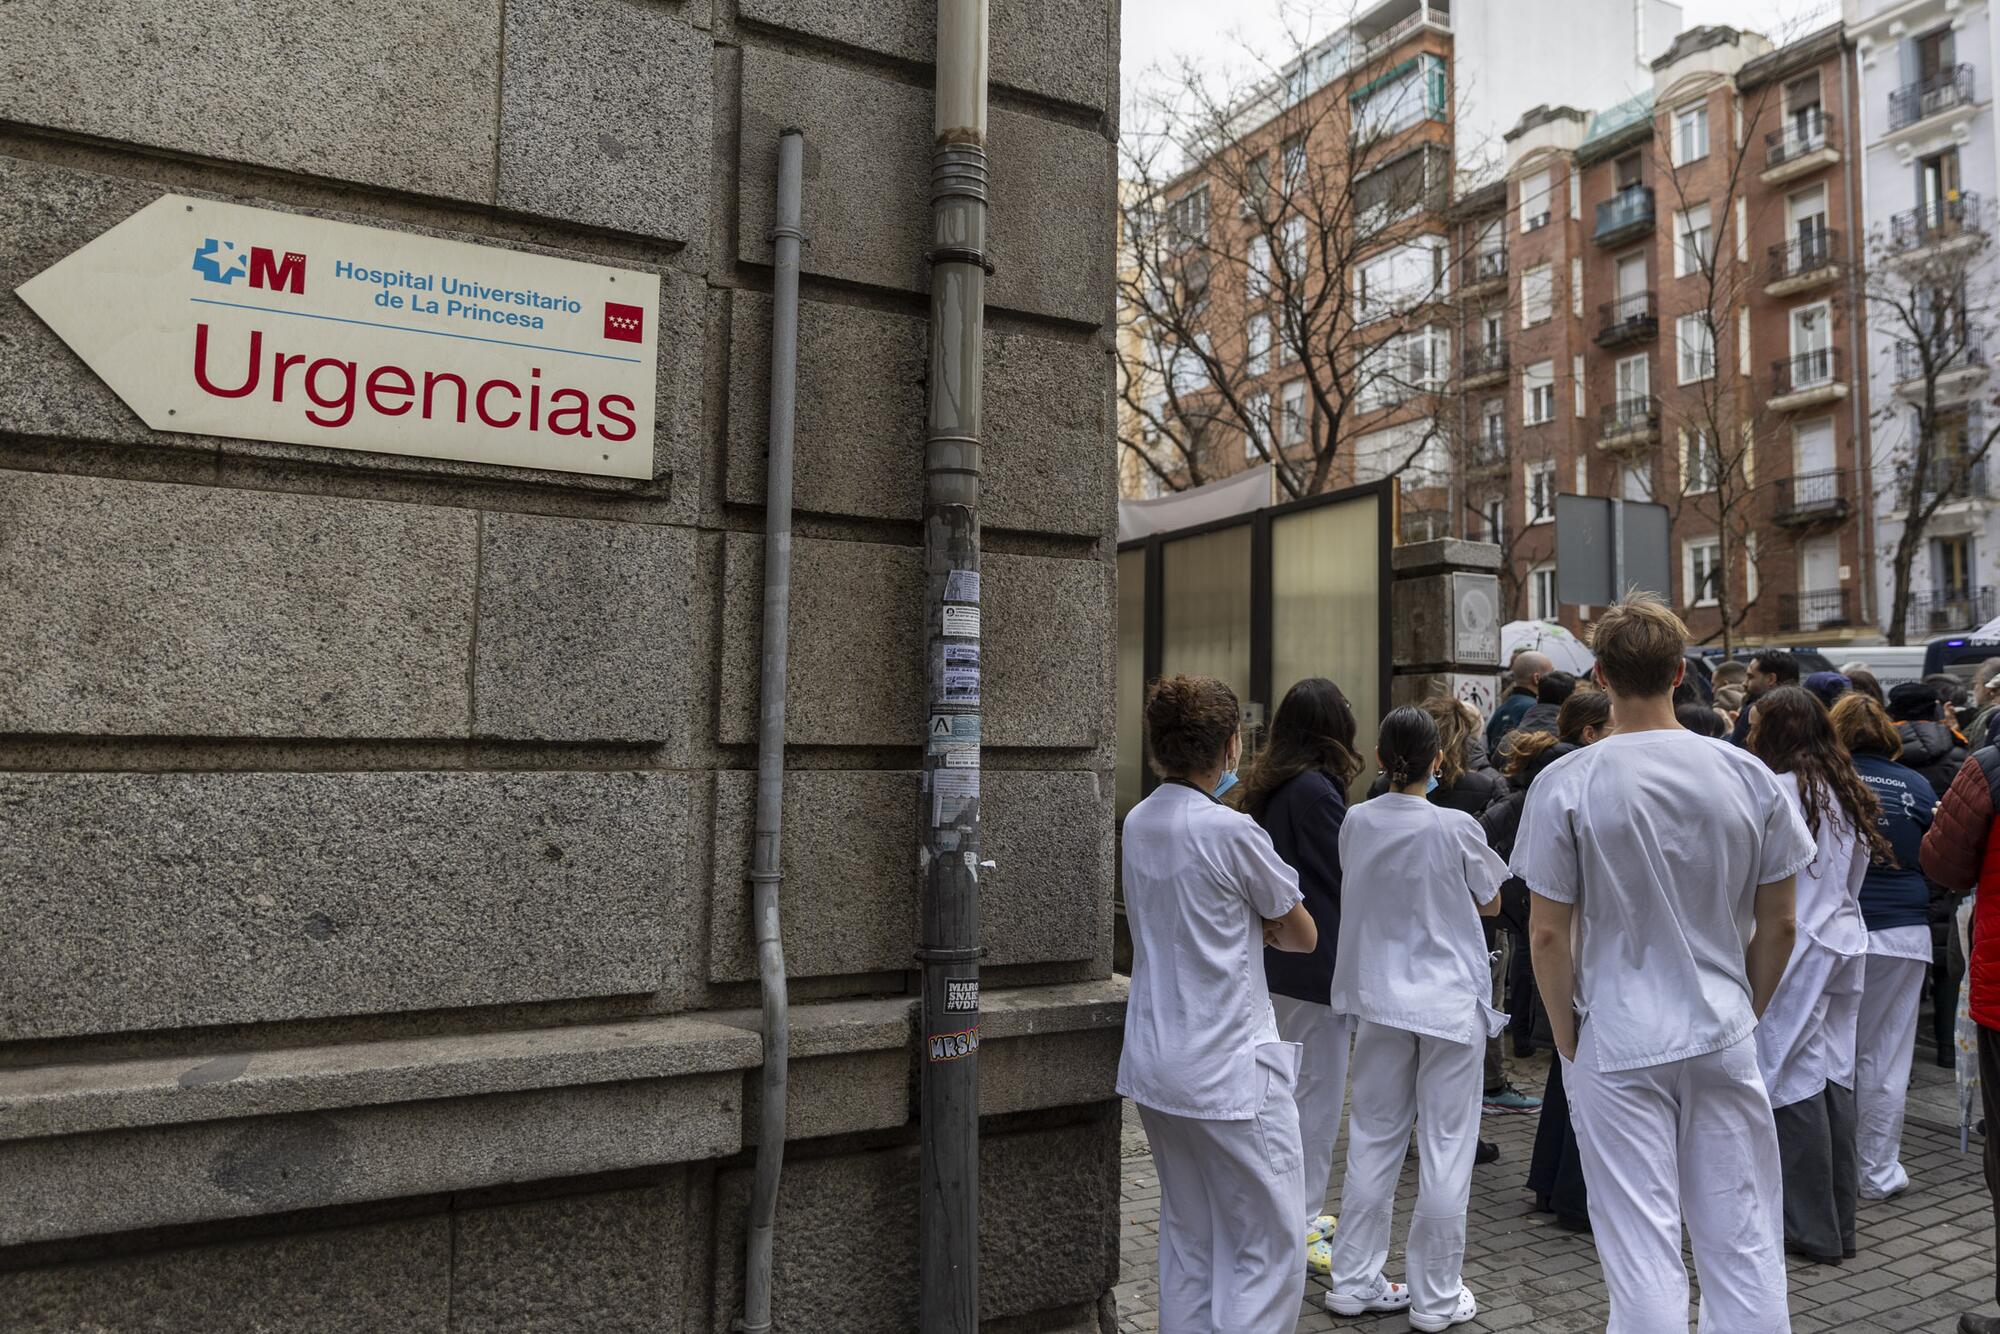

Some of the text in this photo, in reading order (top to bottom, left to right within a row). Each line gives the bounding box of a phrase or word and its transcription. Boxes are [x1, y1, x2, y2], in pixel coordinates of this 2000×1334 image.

[336, 260, 581, 314] Hospital Universitario
[375, 290, 544, 331] de La Princesa
[194, 323, 636, 442] Urgencias
[1858, 774, 1907, 788] FISIOLOGIA
[1877, 817, 1889, 826] CA
